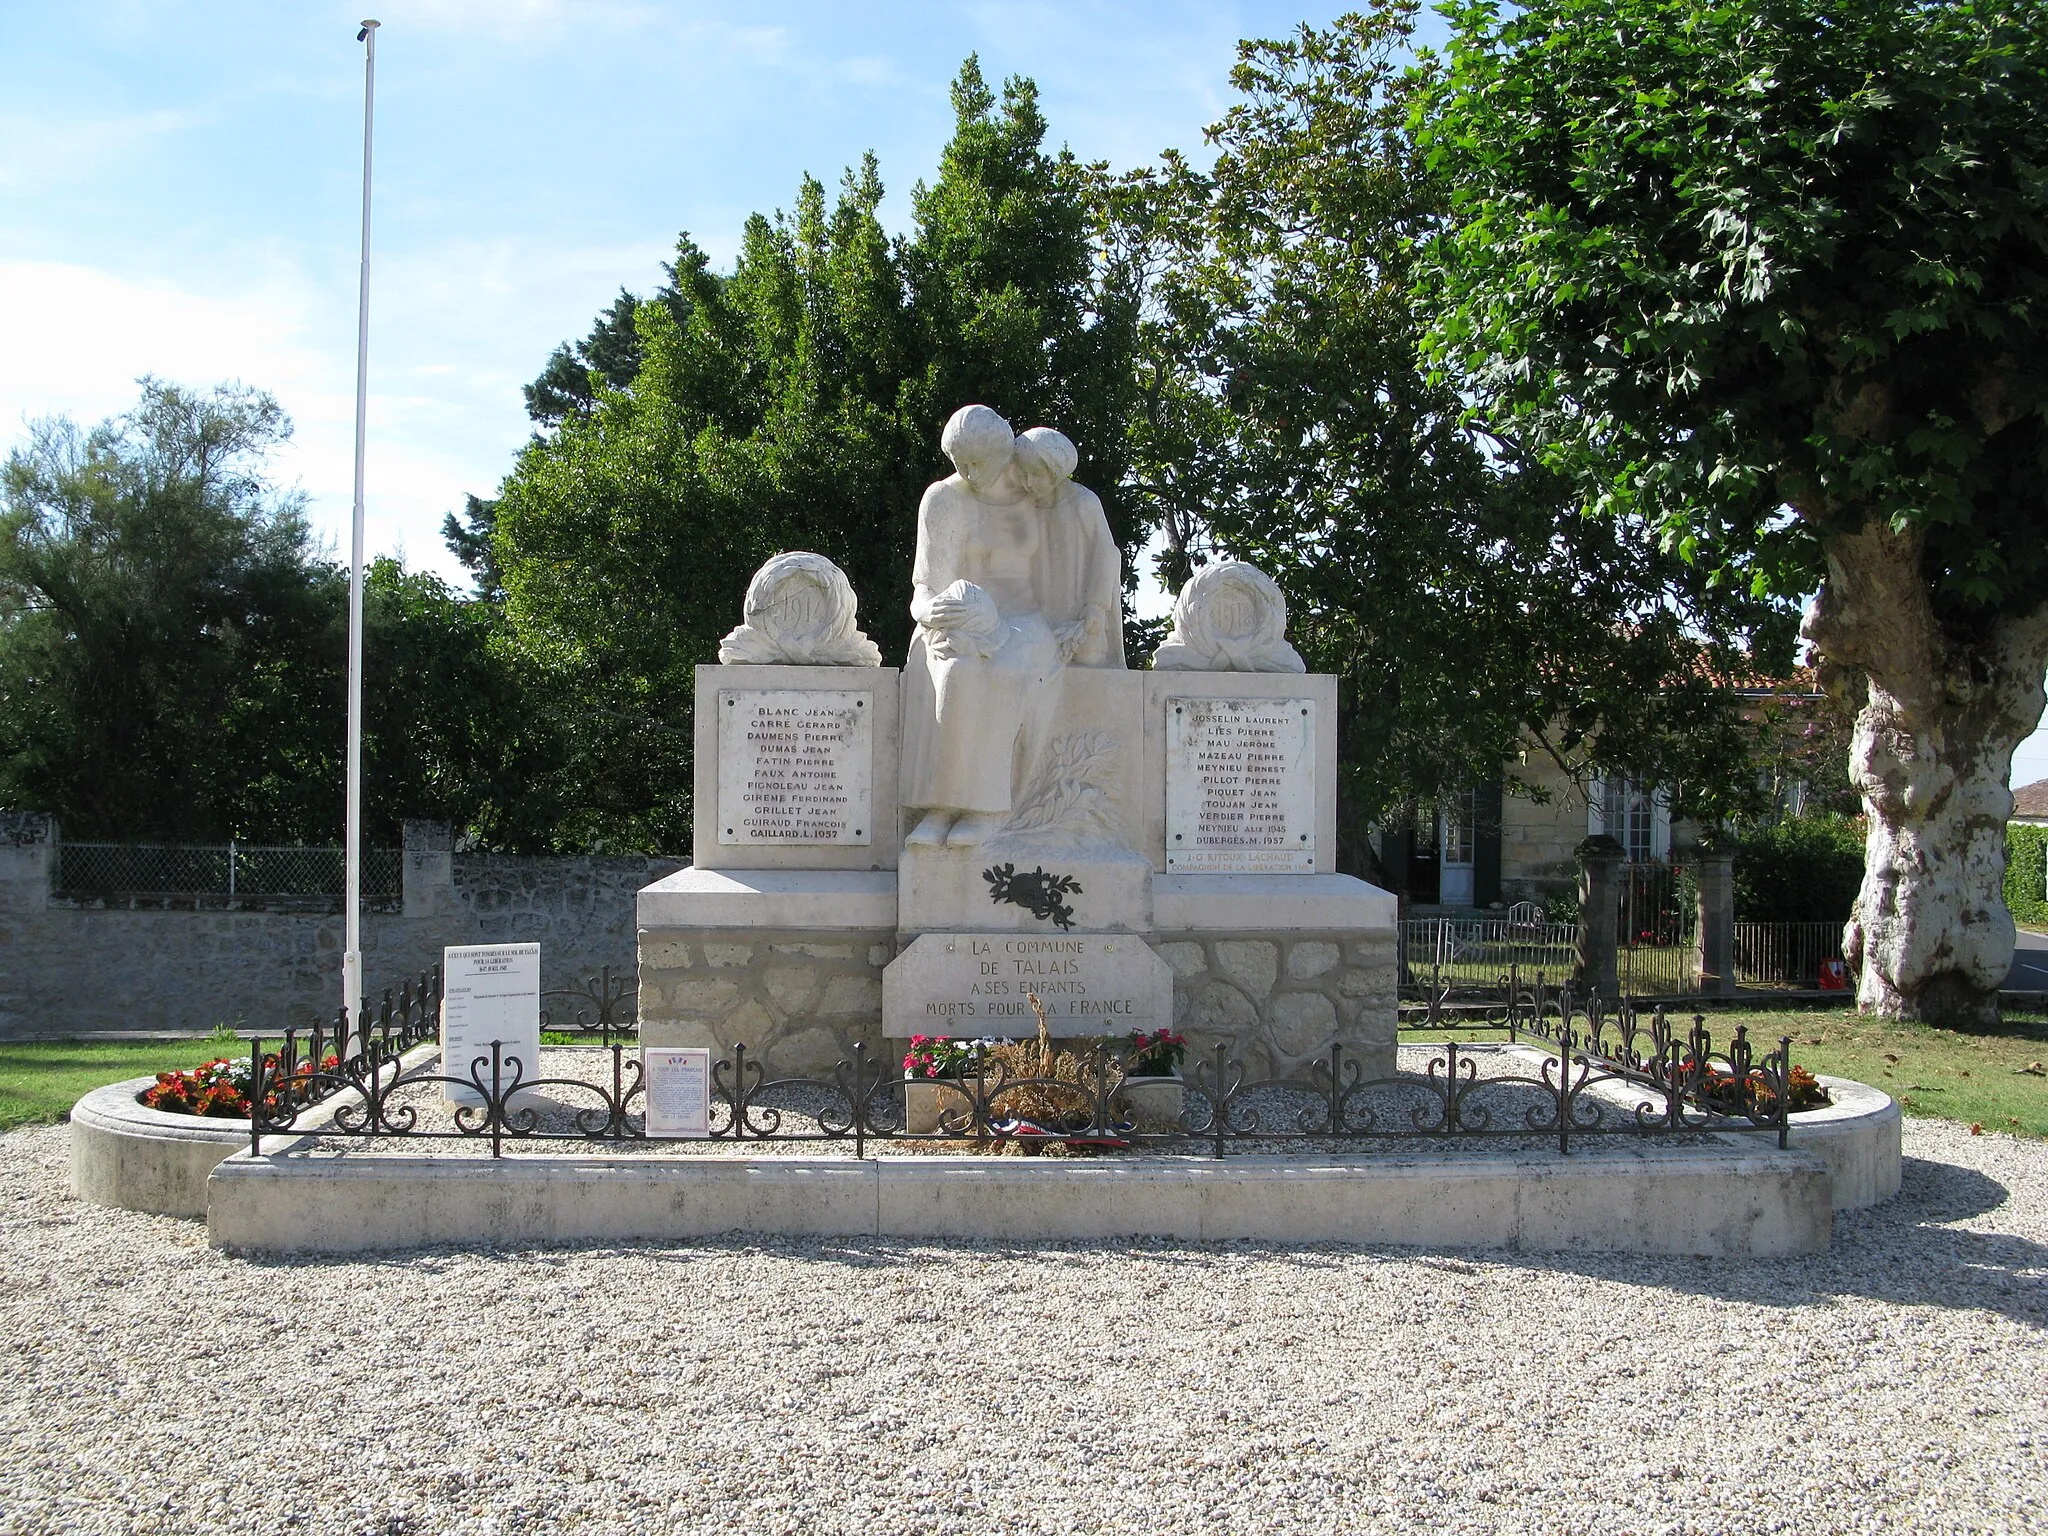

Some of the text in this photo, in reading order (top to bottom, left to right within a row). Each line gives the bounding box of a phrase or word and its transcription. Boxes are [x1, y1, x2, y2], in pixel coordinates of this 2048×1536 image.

[758, 707, 834, 717] BLANC JEAN
[1192, 715, 1290, 725] JOSSELIN LAURENT
[747, 732, 844, 742] DAUMENS PIERRE
[1237, 728, 1275, 737] PIERRE
[1207, 740, 1231, 748] MAU
[760, 745, 831, 754] DUMAS JEAN
[1198, 752, 1285, 761] MAZEAU PIERRE
[756, 757, 835, 766] FATIN PIERRE
[1197, 764, 1286, 773] MEYNIEU ERNEST
[754, 770, 837, 779] FAUX ANTOINE
[1203, 776, 1282, 785] PILLOT PIERRE
[814, 783, 843, 791] JEAN
[1207, 788, 1277, 797] PIQUET JEAN
[791, 795, 848, 803] FERDINAND
[1205, 800, 1278, 809] TOUJAN JEAN
[754, 807, 837, 816] GRILLET JEAN
[1199, 812, 1285, 821] VERDIER PIERRE
[743, 818, 791, 827] GUIRAUD
[1198, 824, 1239, 832] MEYNIEU
[972, 941, 1084, 956] LA COMMUNE
[980, 958, 1079, 975] DE TALAIS
[971, 981, 1086, 995] A SES ENFANTS
[926, 1002, 976, 1016] MORTS
[988, 1001, 1025, 1016] POUR
[1070, 999, 1132, 1015] FRANCE
